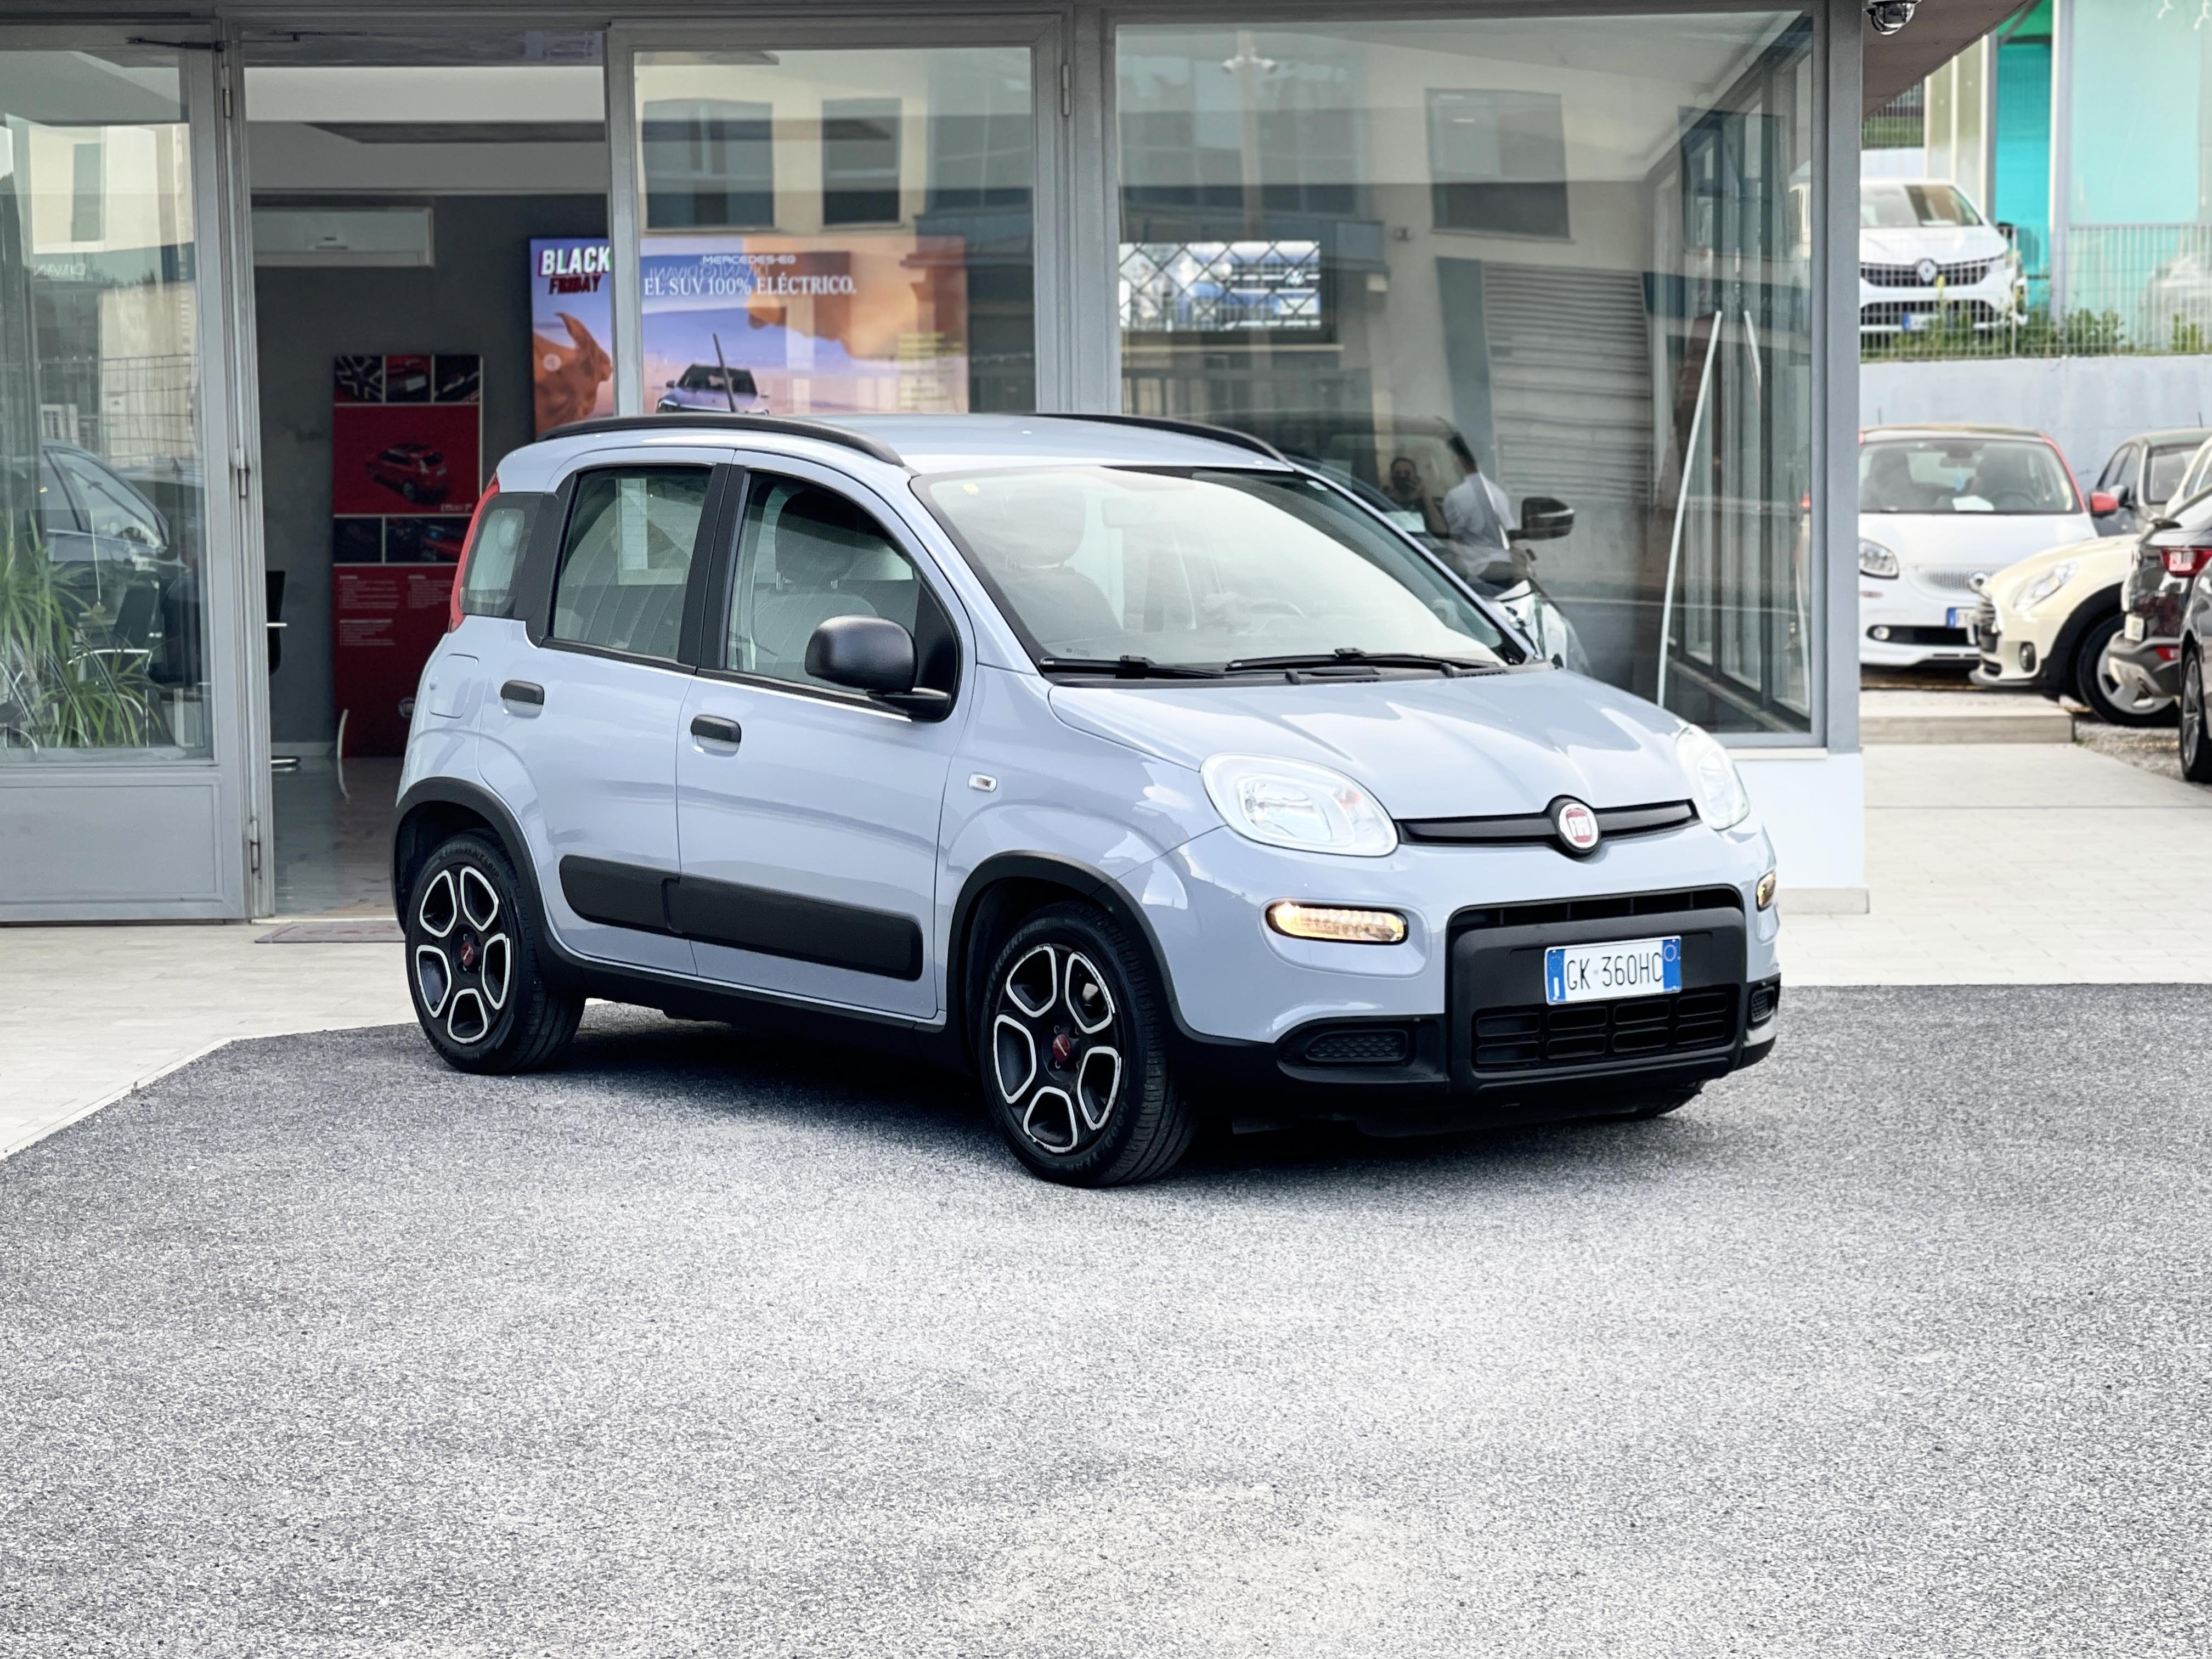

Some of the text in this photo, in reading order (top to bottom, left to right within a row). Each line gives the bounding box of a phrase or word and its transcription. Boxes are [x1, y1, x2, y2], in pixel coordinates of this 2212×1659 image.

[539, 247, 610, 276] BLACK
[548, 275, 601, 295] FRIDAY
[644, 270, 857, 296] EL SUV 100% ELÉCTRICO.
[1567, 816, 1592, 837] FIAT
[1567, 952, 1663, 990] GK 360HC
